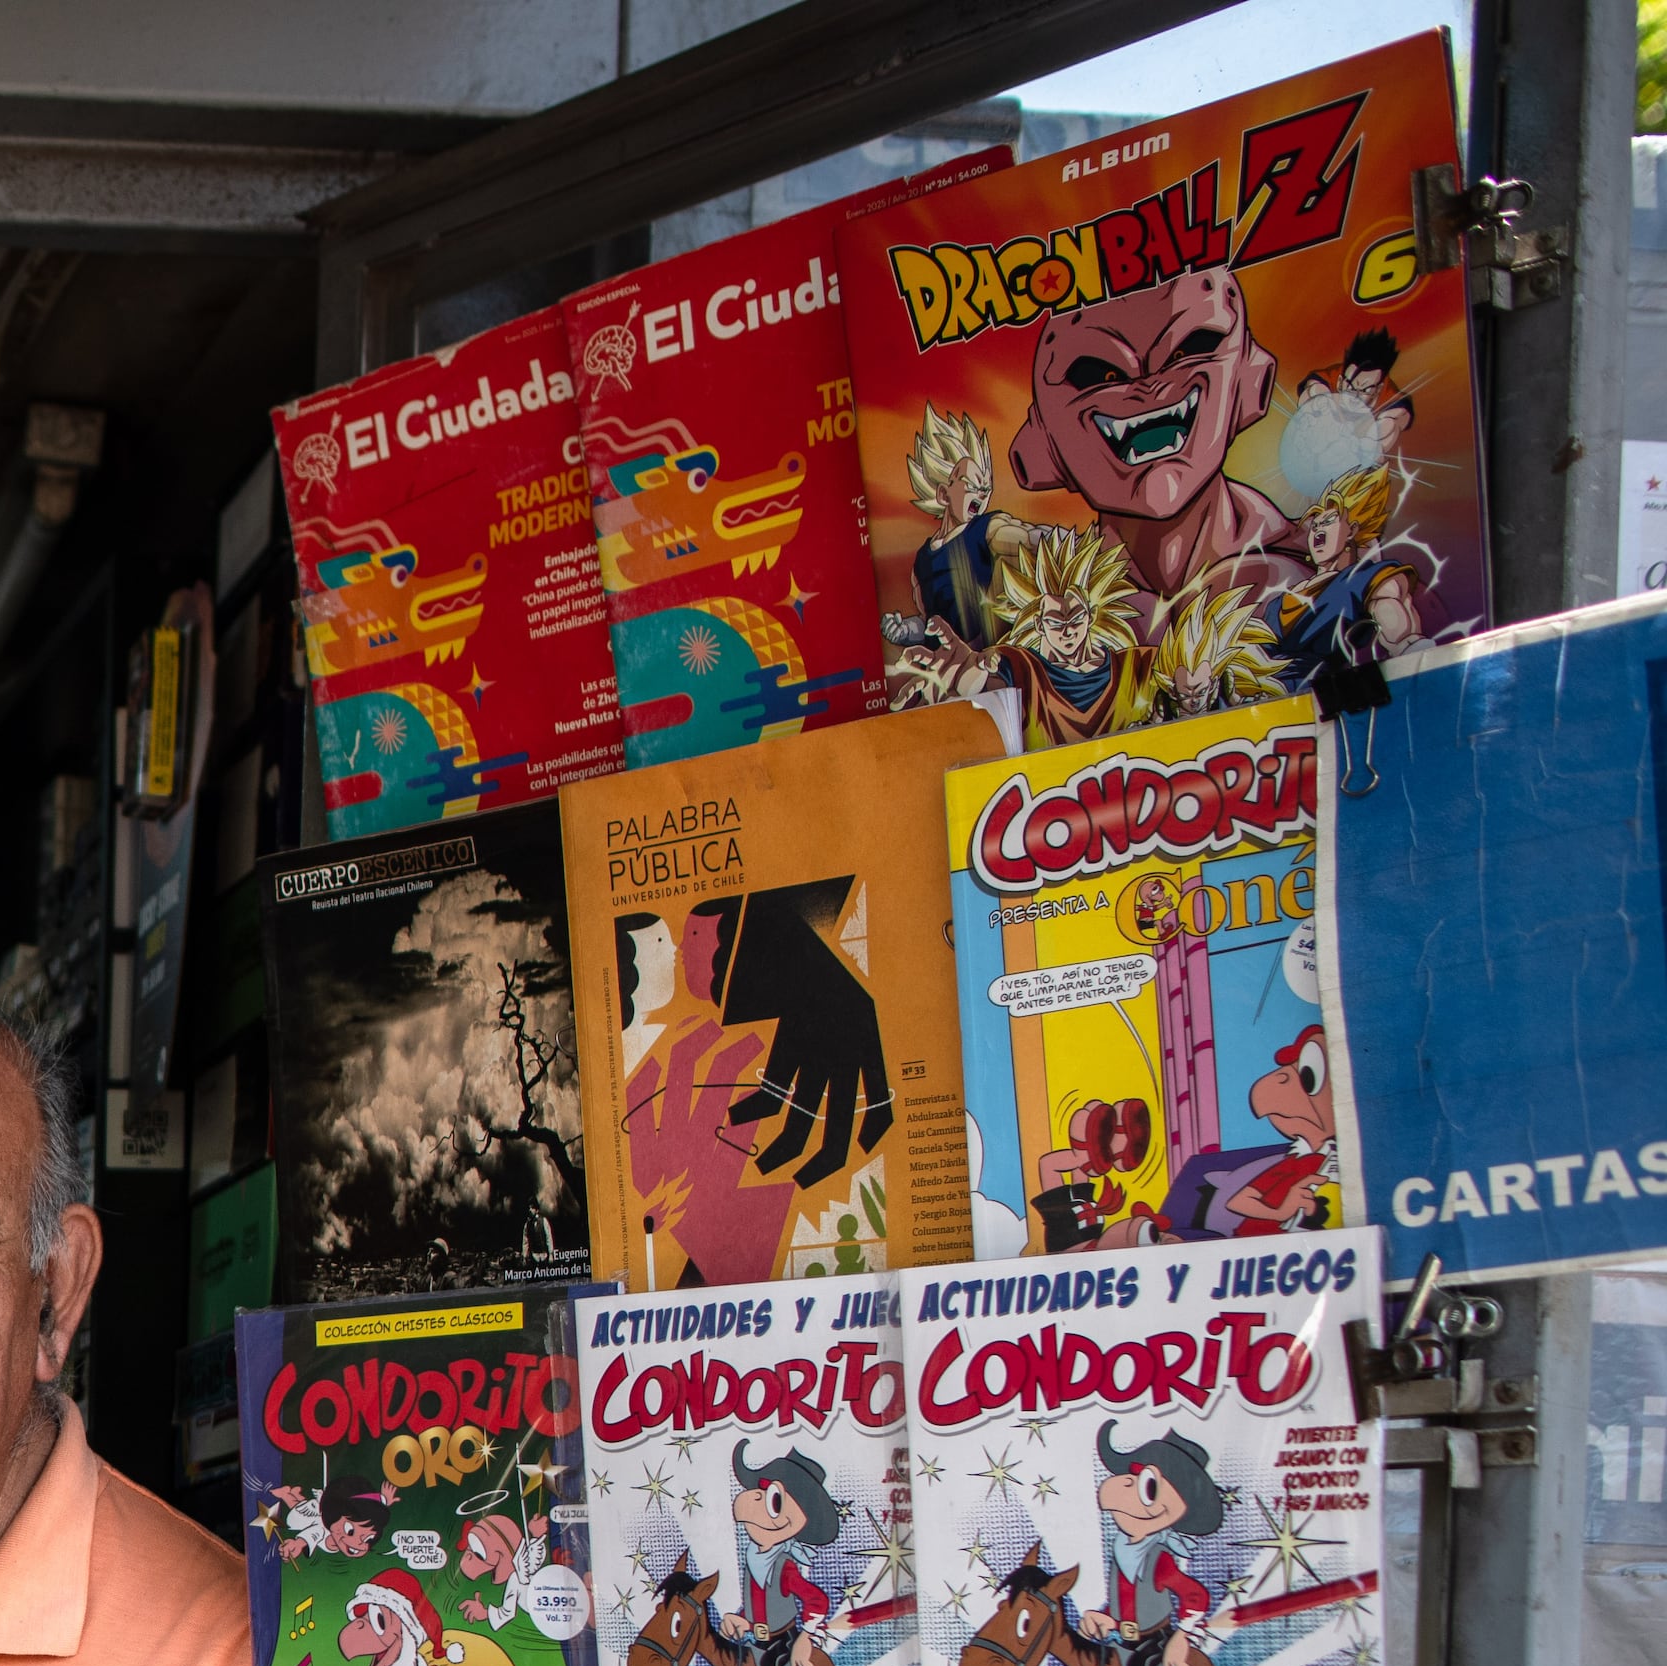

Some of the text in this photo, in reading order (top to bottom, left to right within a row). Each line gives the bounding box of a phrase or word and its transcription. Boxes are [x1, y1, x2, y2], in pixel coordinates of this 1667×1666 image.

[1061, 131, 1171, 183] ÁLBUM
[1228, 88, 1371, 271] Z
[1352, 230, 1417, 305] 6
[577, 282, 641, 313] EDICIÓN ESPECIAL
[642, 299, 696, 364] El
[344, 358, 575, 471] El Ciudada
[606, 797, 742, 848] PALABRA
[982, 736, 1316, 883] CONDORIT
[280, 862, 361, 897] CUERPO
[612, 872, 746, 907] UNIVERSIDAD DE CHILE
[988, 891, 1110, 929] PRESENTA A
[1000, 970, 1149, 1003] QUE LIMPIARME LOS PIES
[1016, 981, 1132, 1011] ANTES DE ENTRAR!
[1033, 973, 1055, 986] TÍO,
[1062, 966, 1082, 981] ASÍ
[1083, 967, 1101, 978] NO
[1105, 959, 1144, 974] TENGO
[913, 1065, 925, 1075] 33
[909, 1157, 966, 1172] Mireya Dávila
[1394, 1143, 1667, 1228] CARTAS
[504, 1265, 569, 1281] Marco Antonio
[917, 1247, 1357, 1324] ACTIVIDADES Y JUEGOS
[323, 1309, 515, 1341] COLECCIÓN CHISTES CLÁSICOS
[591, 1298, 774, 1348] ACTIVIDADES
[795, 1296, 815, 1333] Y
[592, 1340, 906, 1443] CONDORITO
[918, 1311, 1313, 1427] CONDORITO
[263, 1353, 578, 1454] CONDORITO
[382, 1425, 489, 1488] ORO
[536, 1596, 577, 1607] $3.990
